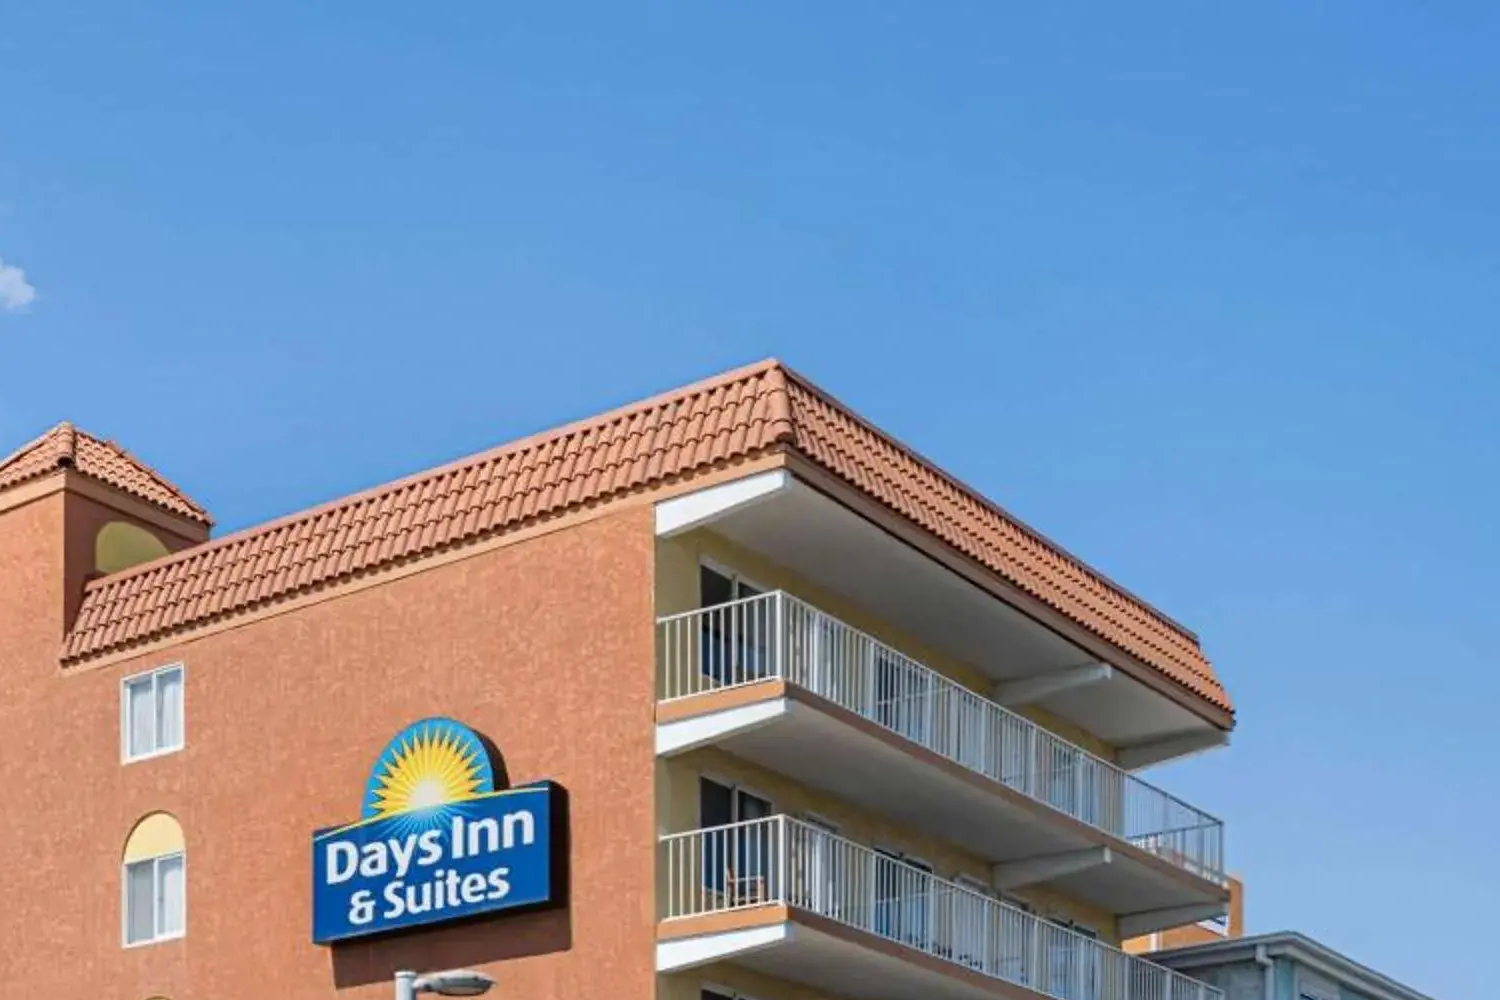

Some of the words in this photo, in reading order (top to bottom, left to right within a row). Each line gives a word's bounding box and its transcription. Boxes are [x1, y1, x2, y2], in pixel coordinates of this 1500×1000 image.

[326, 829, 443, 884] Days
[452, 809, 534, 859] Inn
[348, 890, 376, 925] &
[384, 867, 510, 919] Suites
